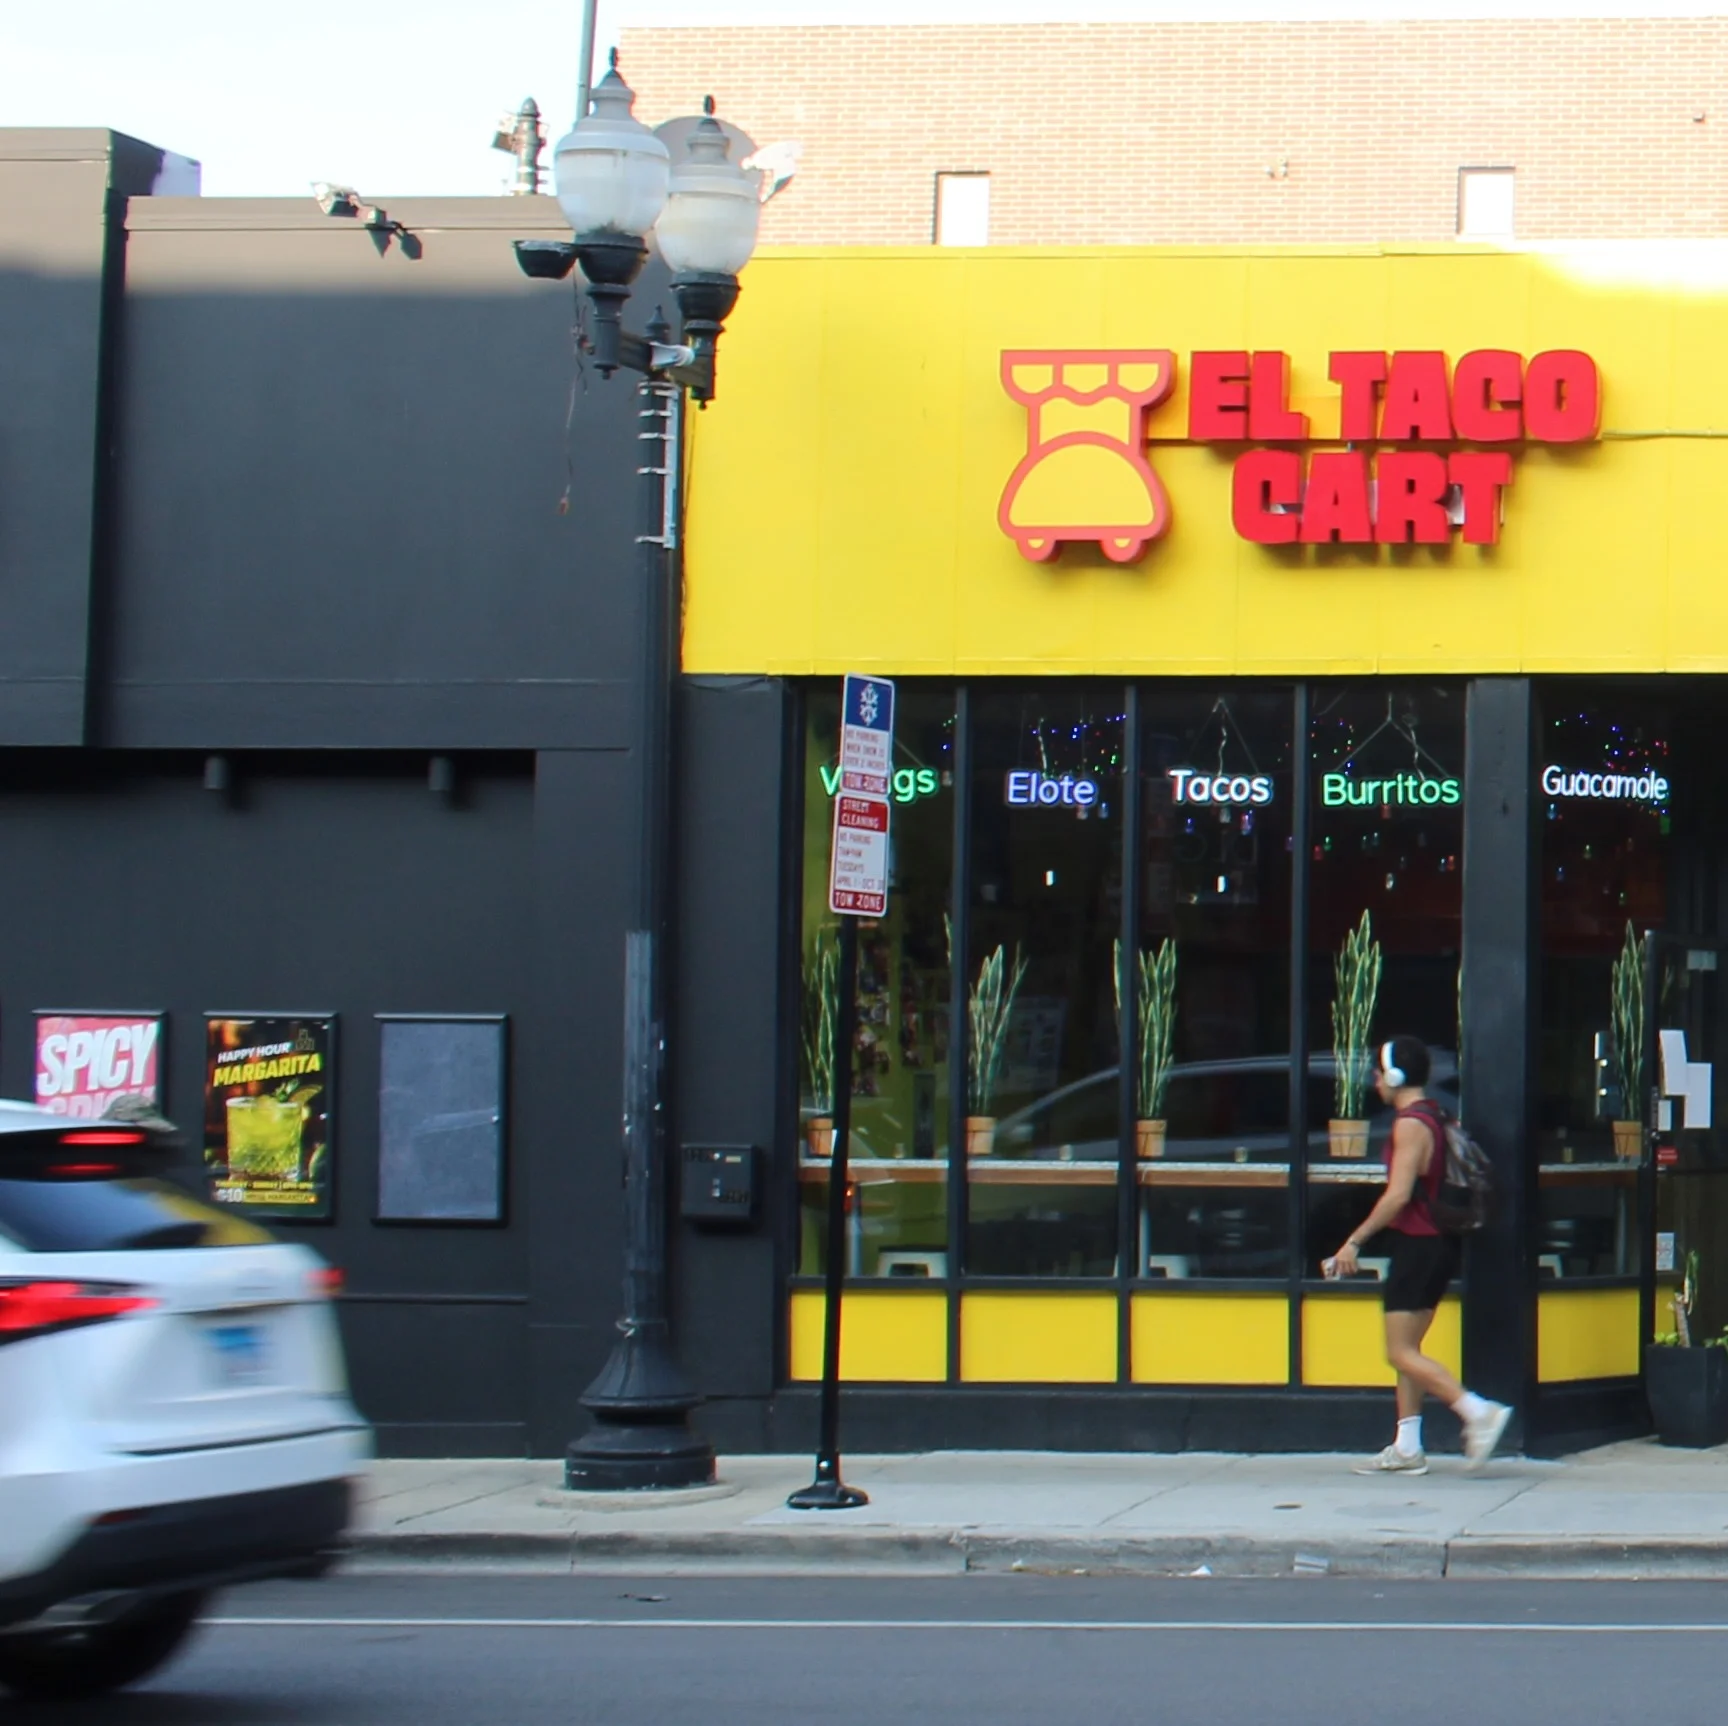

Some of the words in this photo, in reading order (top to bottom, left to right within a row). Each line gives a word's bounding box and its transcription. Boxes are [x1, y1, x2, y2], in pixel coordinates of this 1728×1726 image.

[1187, 351, 1310, 440] EL
[1328, 349, 1598, 443] TACO
[1232, 449, 1512, 544] CART
[1007, 771, 1096, 804] Elote
[1168, 769, 1271, 803] Tacos
[1322, 773, 1461, 805] Burritos
[1542, 765, 1668, 800] Guacamole
[841, 812, 879, 829] CLEANING
[835, 891, 854, 907] TOW
[855, 894, 882, 911] ZONE
[37, 1021, 160, 1097] SPICY
[217, 1047, 256, 1063] HAPPY
[256, 1041, 292, 1057] HOUR
[212, 1053, 321, 1087] MARGARITA
